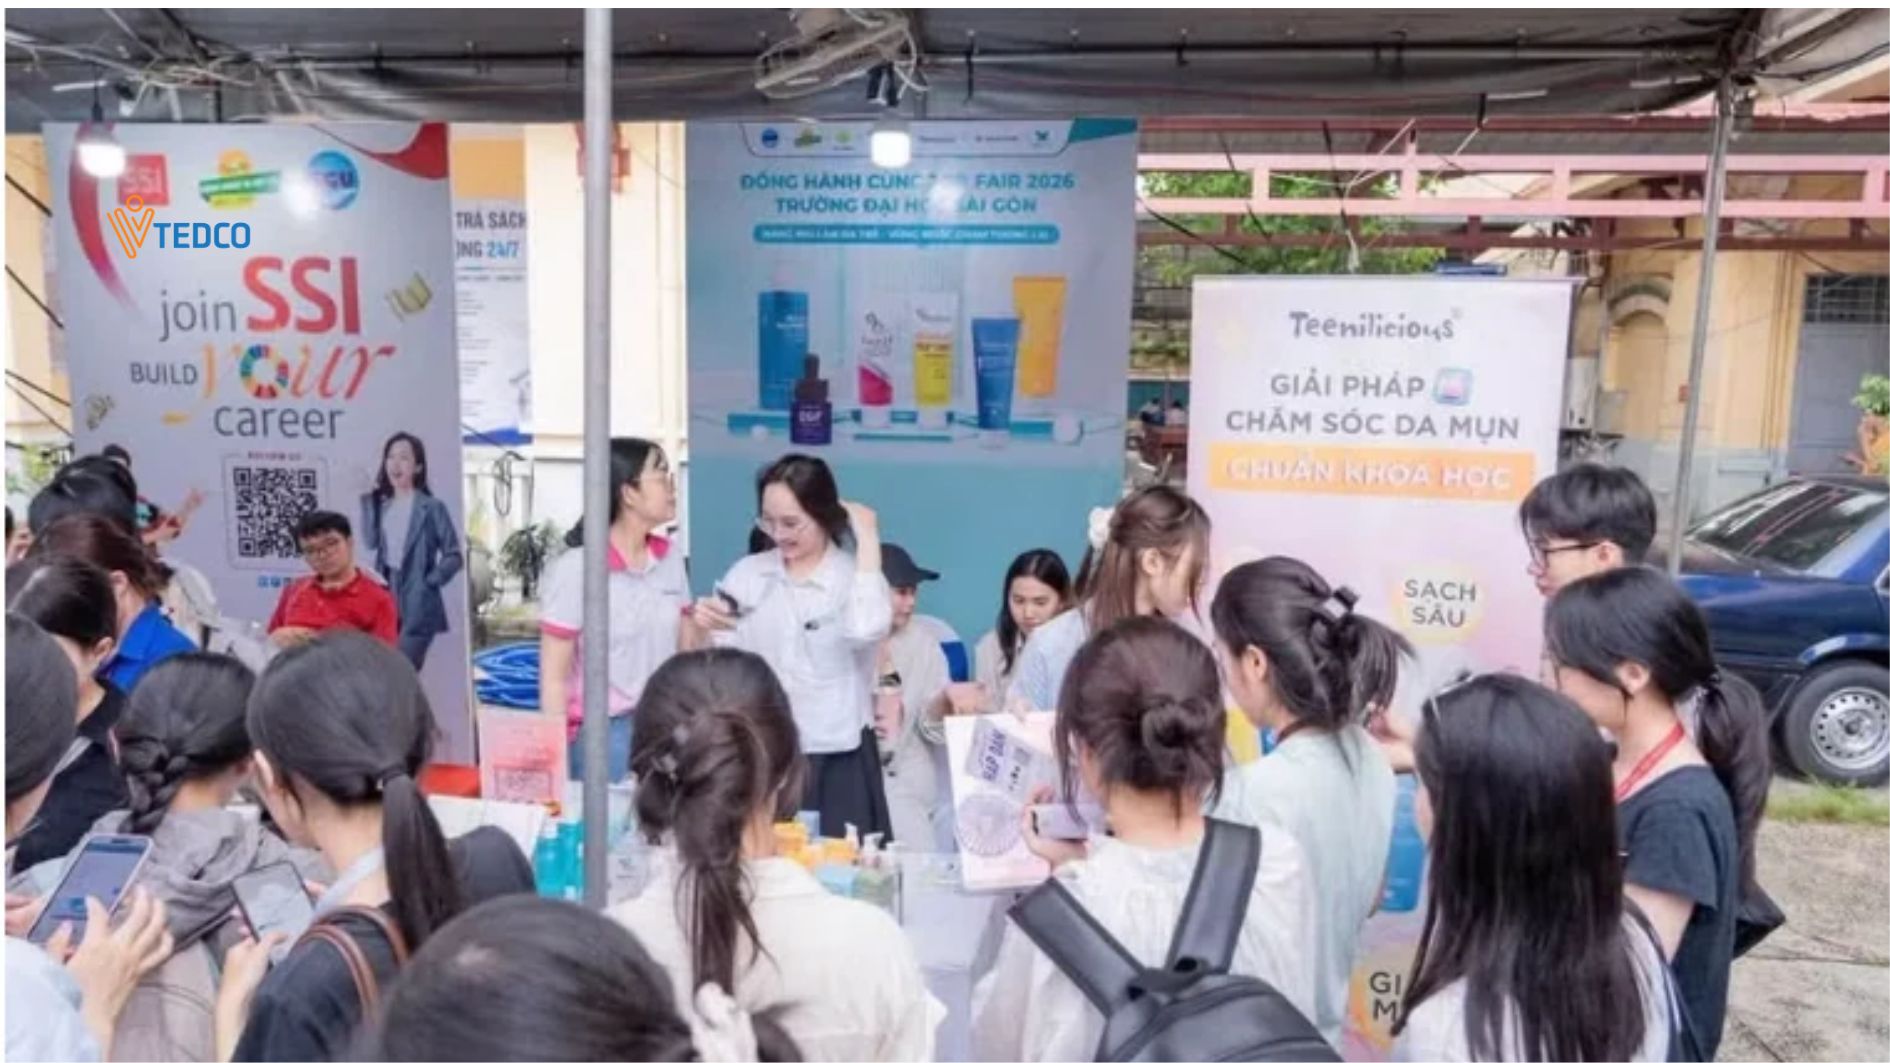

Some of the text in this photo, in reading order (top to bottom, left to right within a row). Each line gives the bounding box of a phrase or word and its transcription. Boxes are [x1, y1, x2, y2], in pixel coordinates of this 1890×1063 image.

[975, 173, 1021, 189] FAIR
[1028, 172, 1075, 189] 2026
[159, 256, 361, 342] join SSI
[130, 362, 198, 385] BUILD
[1270, 367, 1425, 399] GIẢI PHÁP
[213, 404, 345, 439] career
[1226, 406, 1519, 444] CHĂM SÓC DA MỤN
[1344, 455, 1430, 487] KHOA
[1441, 464, 1513, 494] HỌC
[1404, 579, 1476, 628] SẠCH SÂU
[1369, 971, 1402, 995] GI
